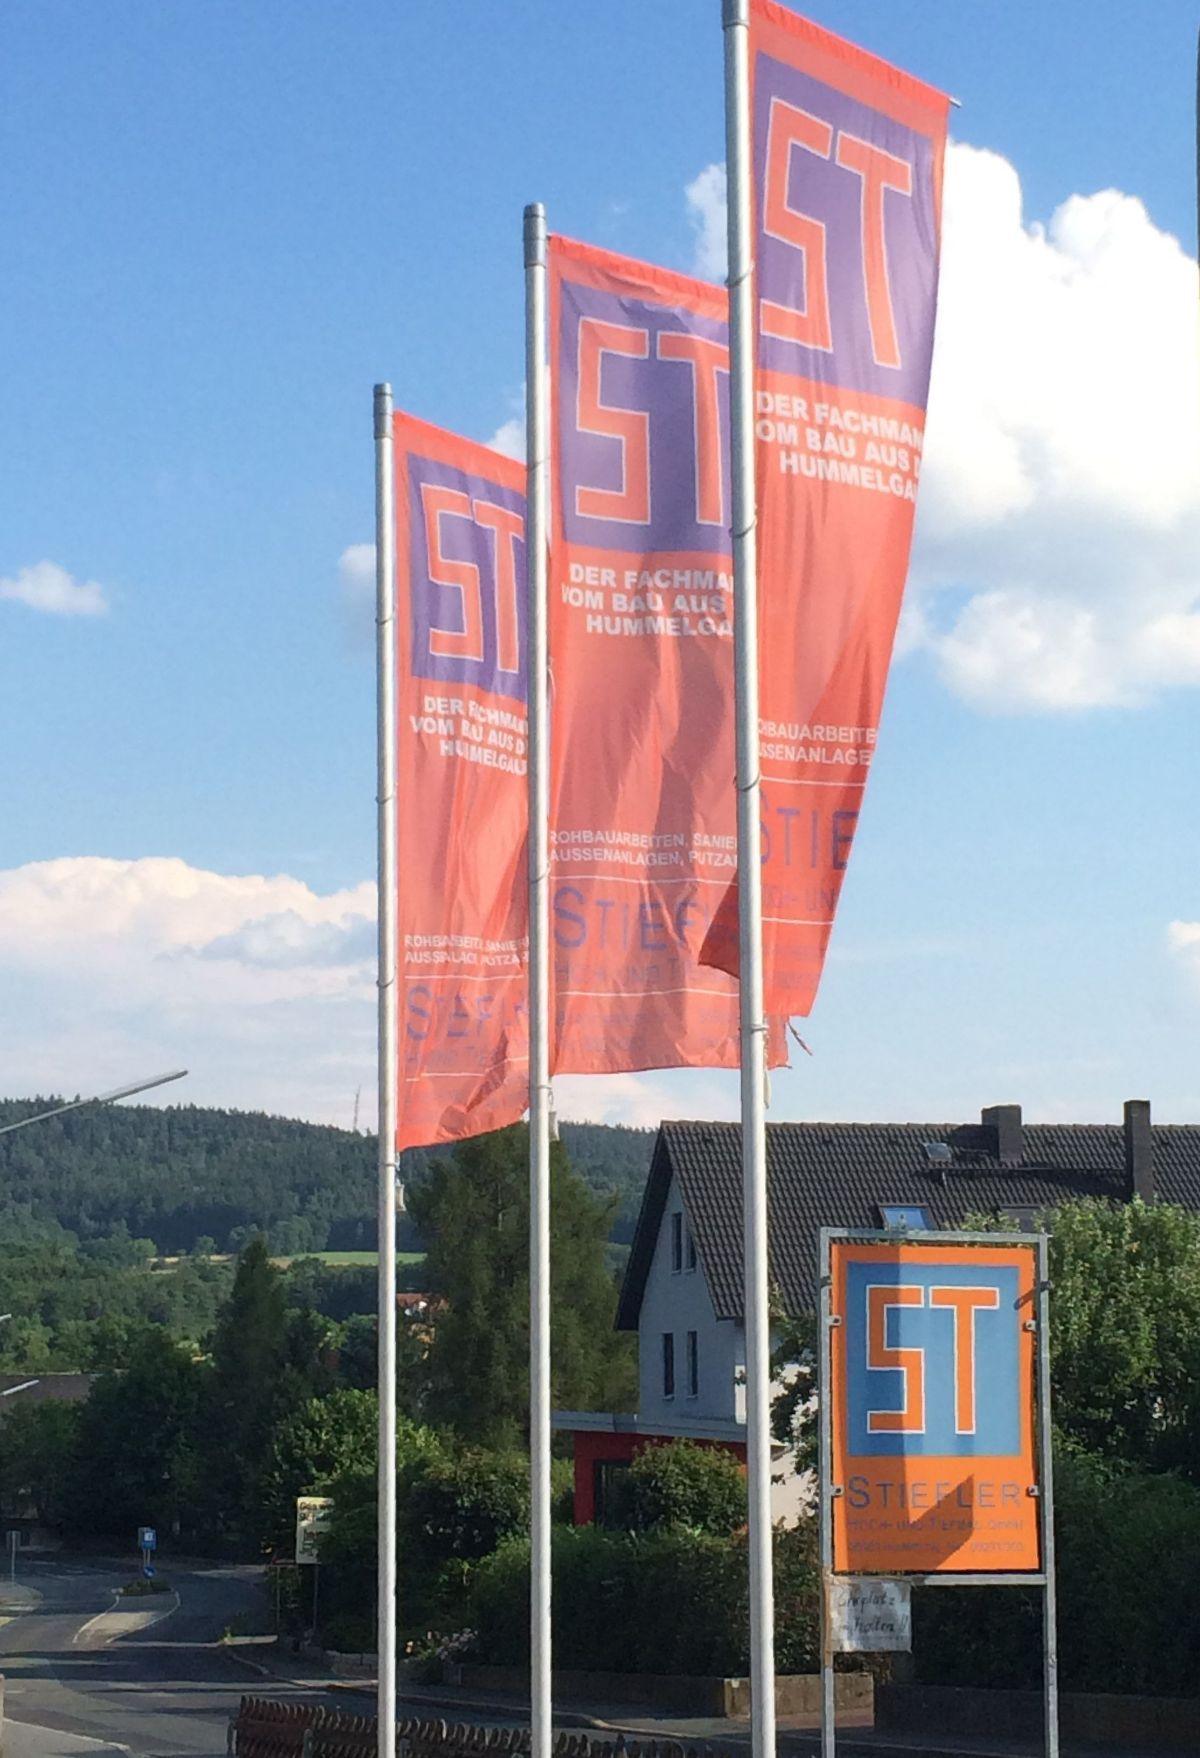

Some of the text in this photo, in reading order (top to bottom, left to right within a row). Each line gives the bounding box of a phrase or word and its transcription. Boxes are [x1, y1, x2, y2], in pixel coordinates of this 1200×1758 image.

[760, 95, 913, 370] ST
[575, 315, 730, 526] ST
[756, 390, 809, 421] DER
[755, 418, 799, 446] OM
[805, 427, 857, 458] BAU
[865, 441, 910, 472] AUS
[420, 482, 525, 674] ST
[569, 563, 616, 588] DER
[612, 591, 664, 612] BAU
[672, 594, 727, 613] AUS
[423, 695, 464, 715] DER
[409, 715, 454, 736] VOM
[487, 729, 514, 751] AUS
[693, 833, 737, 850] SANIE
[866, 1285, 1000, 1435] ST
